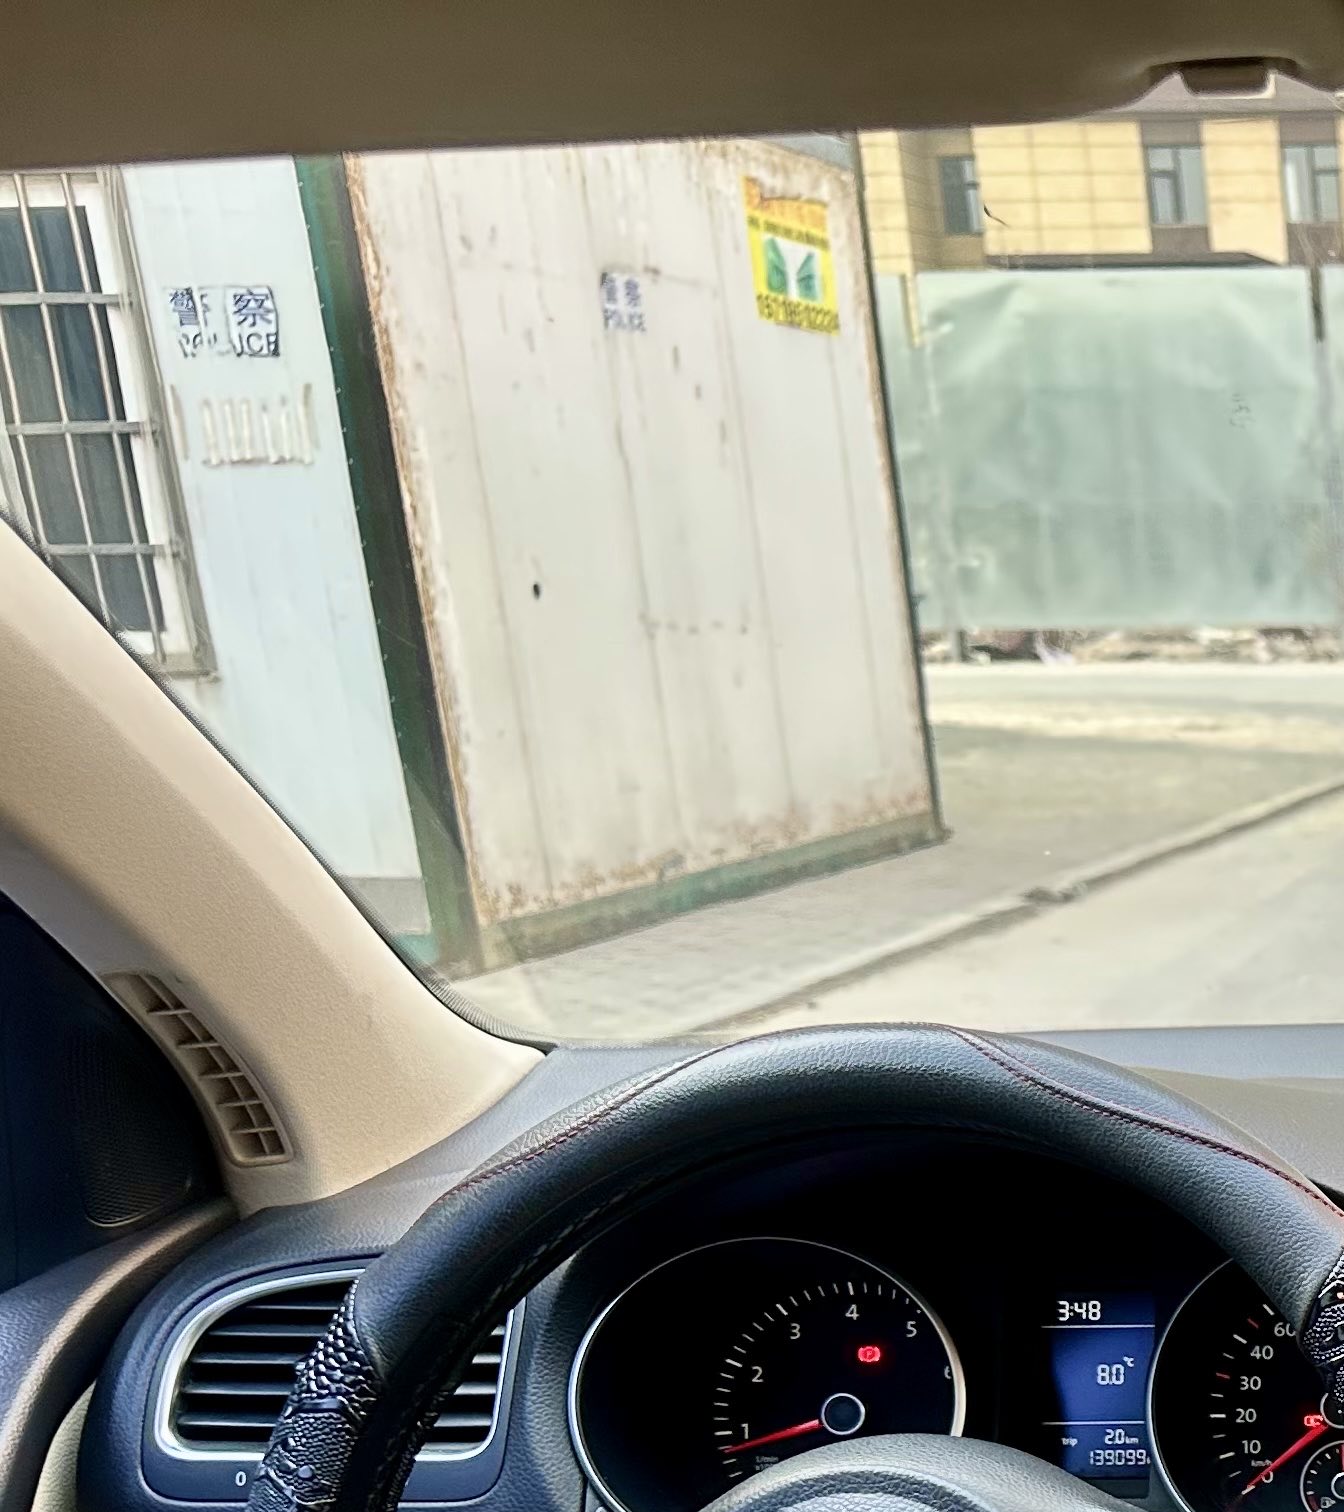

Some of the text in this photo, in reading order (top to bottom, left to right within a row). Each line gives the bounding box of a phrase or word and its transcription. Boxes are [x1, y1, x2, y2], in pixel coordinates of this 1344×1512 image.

[845, 1304, 860, 1320] 4
[1057, 1301, 1101, 1321] 3:48
[789, 1323, 801, 1339] 3
[906, 1321, 917, 1337] 5
[1250, 1345, 1274, 1360] 40
[751, 1366, 764, 1383] 2
[1239, 1376, 1262, 1391] 30
[1235, 1408, 1257, 1423] 20
[741, 1423, 750, 1440] 1
[1241, 1440, 1262, 1454] 10
